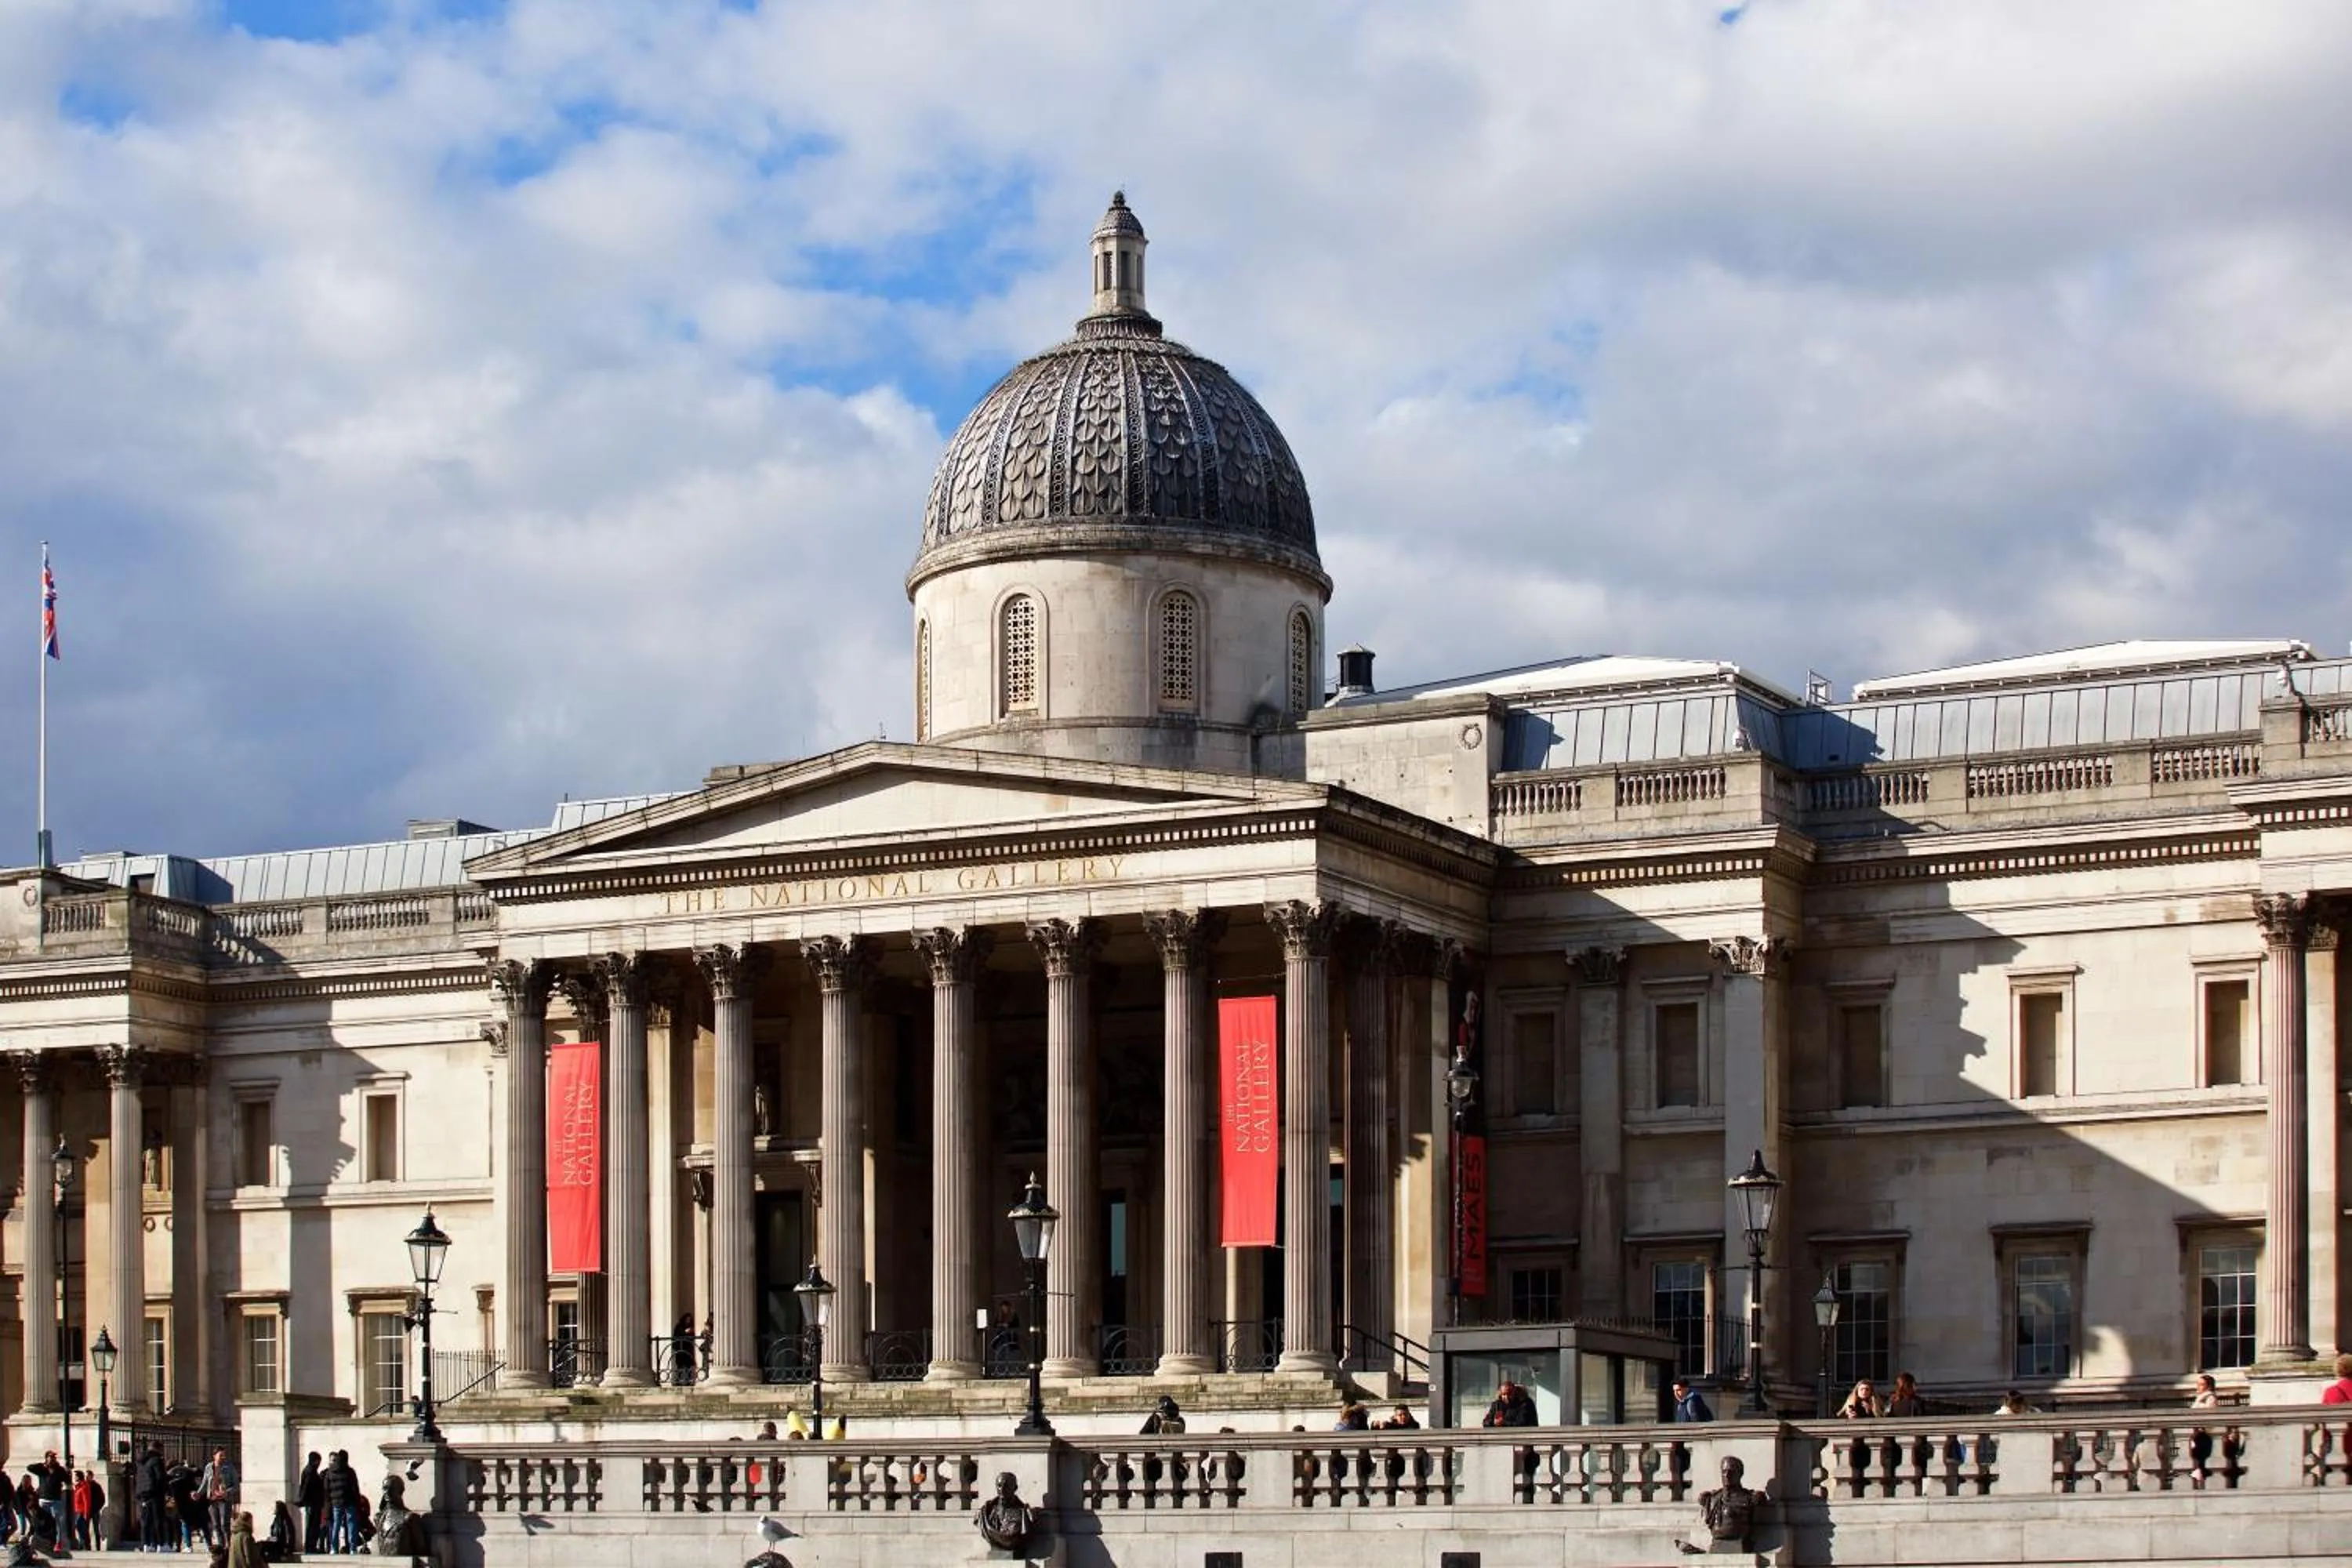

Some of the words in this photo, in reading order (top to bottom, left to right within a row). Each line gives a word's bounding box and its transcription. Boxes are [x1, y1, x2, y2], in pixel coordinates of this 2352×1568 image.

[661, 890, 726, 913] THE
[750, 873, 932, 907] NATIONAL
[957, 857, 1124, 891] GALLERY
[563, 1083, 578, 1185] NATIONAL
[578, 1081, 593, 1185] GALLERY
[1236, 1041, 1251, 1152] NATIONAL
[1254, 1040, 1271, 1153] GALLERY
[1465, 1152, 1482, 1259] MAES
